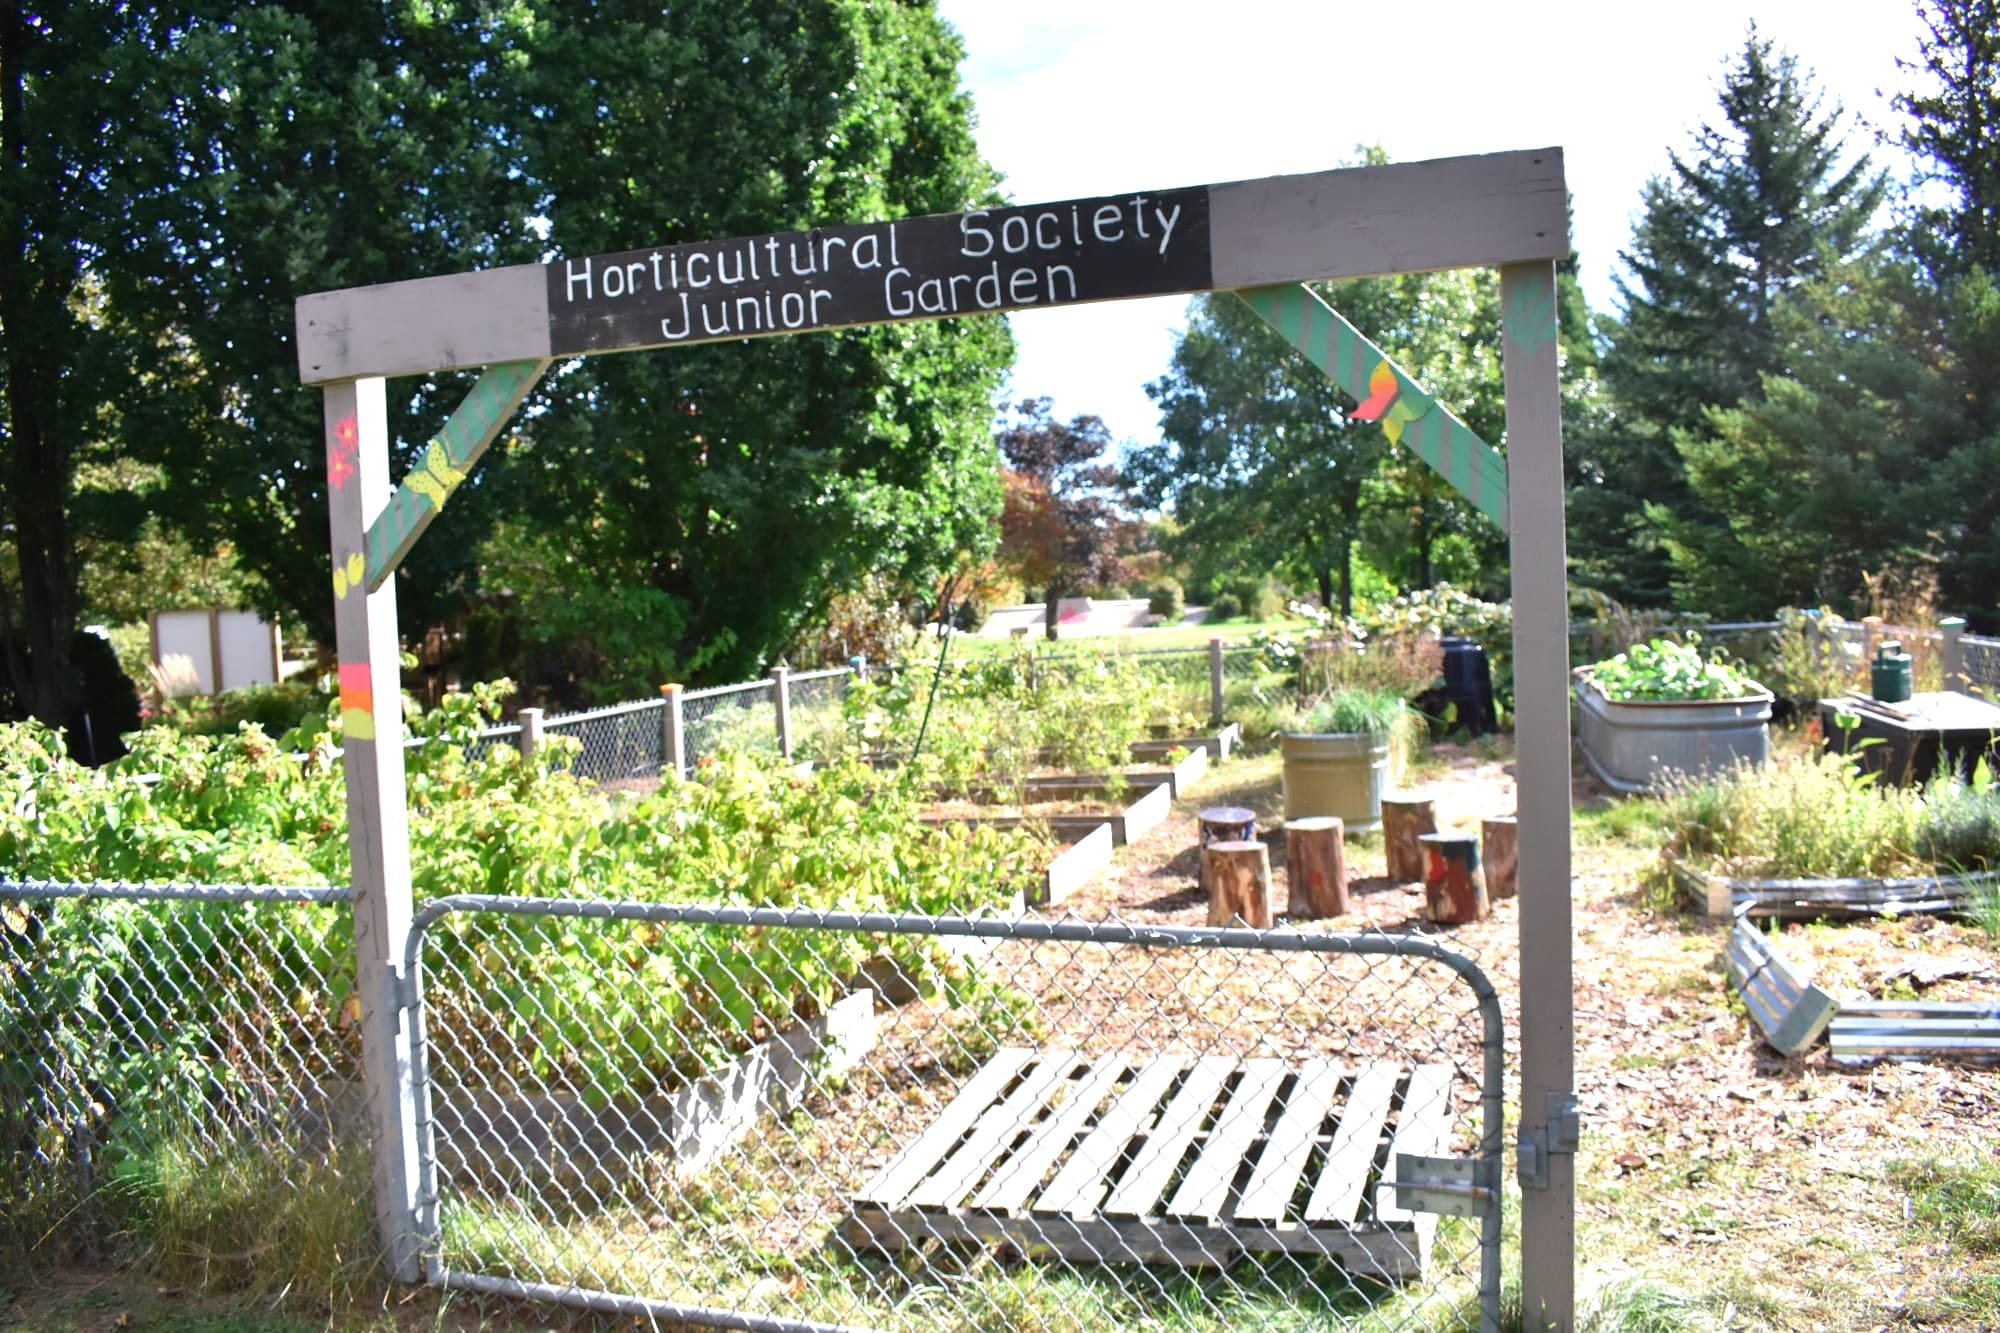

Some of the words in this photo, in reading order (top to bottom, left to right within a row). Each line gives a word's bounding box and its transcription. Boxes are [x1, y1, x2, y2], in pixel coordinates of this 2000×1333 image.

[565, 222, 901, 302] Horticultural
[959, 195, 1181, 255] Society
[661, 289, 832, 340] Junior
[884, 260, 1077, 316] Garden
